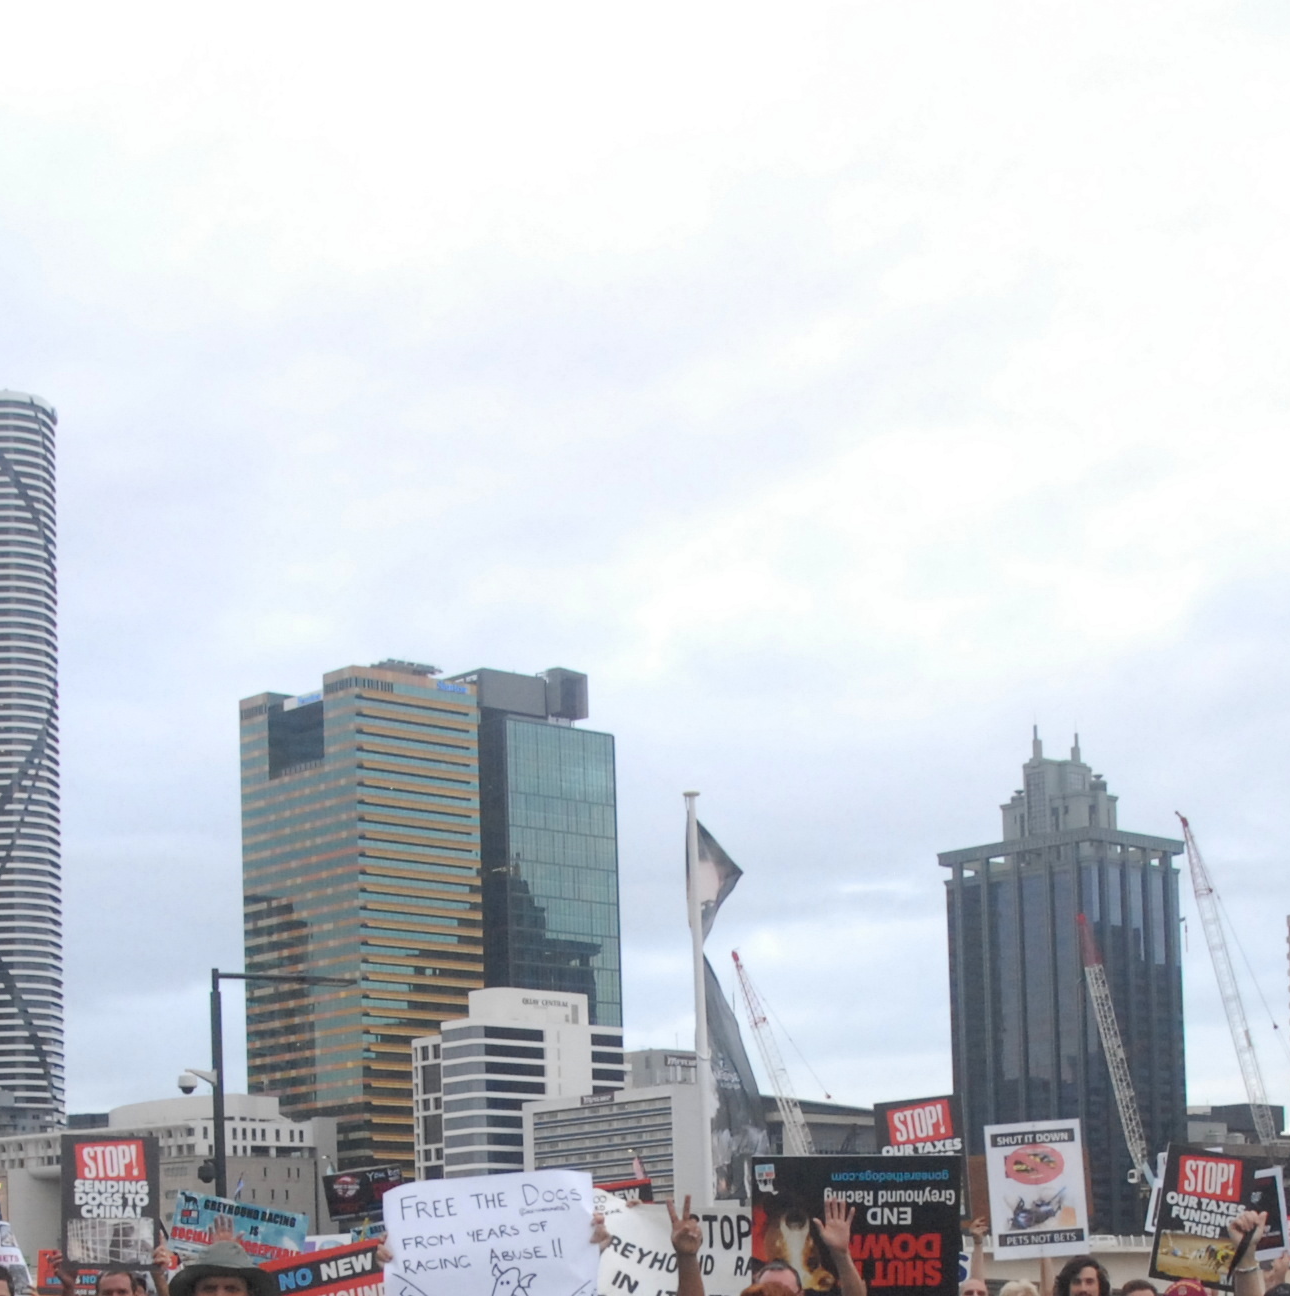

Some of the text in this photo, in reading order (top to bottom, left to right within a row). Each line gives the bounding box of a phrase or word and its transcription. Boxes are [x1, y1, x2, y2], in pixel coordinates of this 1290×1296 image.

[893, 1103, 946, 1142] STOP!
[915, 1137, 963, 1154] TAXES
[996, 1132, 1069, 1146] SHUT IT DOWN
[82, 1144, 139, 1179] STOP!
[74, 1179, 149, 1193] SENDING
[1184, 1159, 1236, 1196] STOP!
[74, 1193, 149, 1206] DOGS TO
[399, 1193, 458, 1221] FREE
[470, 1190, 508, 1210] THE
[878, 1187, 956, 1206] Greyhound
[1166, 1191, 1247, 1216] OUR TAXES
[80, 1205, 142, 1218] CHINA!
[203, 1199, 297, 1228] GREYHOUND RACING
[867, 1207, 912, 1226] END
[249, 1225, 259, 1237] IS
[402, 1219, 549, 1251] FROM YEARS OF
[1006, 1231, 1077, 1245] PETS NOT BETS
[1182, 1221, 1221, 1240] THIS!
[402, 1244, 545, 1274] RACING ABUSE
[278, 1252, 373, 1292] NO NEW
[611, 1270, 639, 1294] IN
[871, 1260, 943, 1286] SHUT
